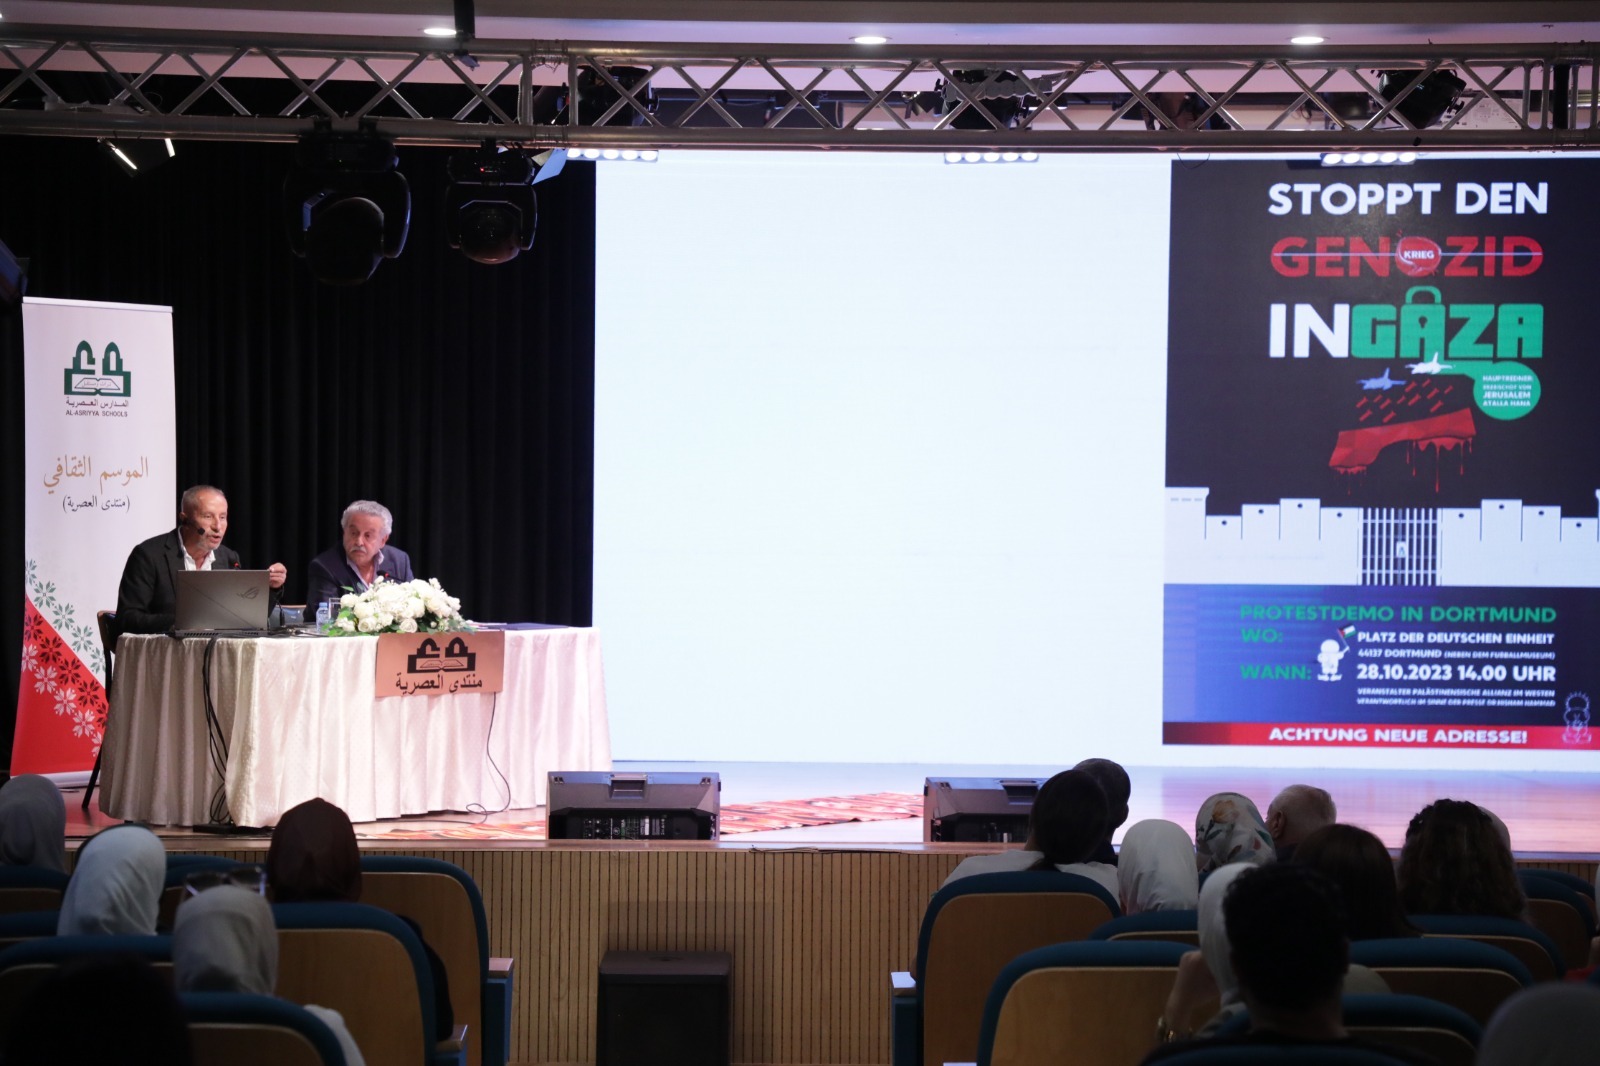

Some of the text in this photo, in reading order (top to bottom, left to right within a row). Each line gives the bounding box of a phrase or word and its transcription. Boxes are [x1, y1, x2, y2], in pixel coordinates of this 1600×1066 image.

[1268, 182, 1549, 215] STOPPT DEN
[1270, 236, 1544, 277] GENOZID
[1403, 249, 1435, 260] KRIEG
[1482, 391, 1531, 399] JERUSALEM
[66, 409, 100, 417] AL-ASRIYYA
[43, 454, 149, 494] الموسم الثقافي
[1240, 605, 1557, 623] PROTESTDEMO IN DORTMUND
[1241, 627, 1283, 643] WO:
[1357, 632, 1555, 644] PLATZ DER DEUTSCHEN EINHEIT
[1358, 649, 1382, 658] 44137
[1384, 649, 1442, 658] DORTMUND
[1472, 651, 1489, 659] DEM
[1240, 664, 1312, 680] WANN:
[1357, 664, 1556, 681] 28.10.2023 14.00 UHR
[396, 672, 483, 695] منتدى العصرية
[1482, 688, 1512, 697] ALLIANZ
[1513, 689, 1523, 697] IM
[1524, 689, 1556, 698] WESTEN
[1268, 727, 1528, 744] ACHTUNG NEUE ADRESSE!
